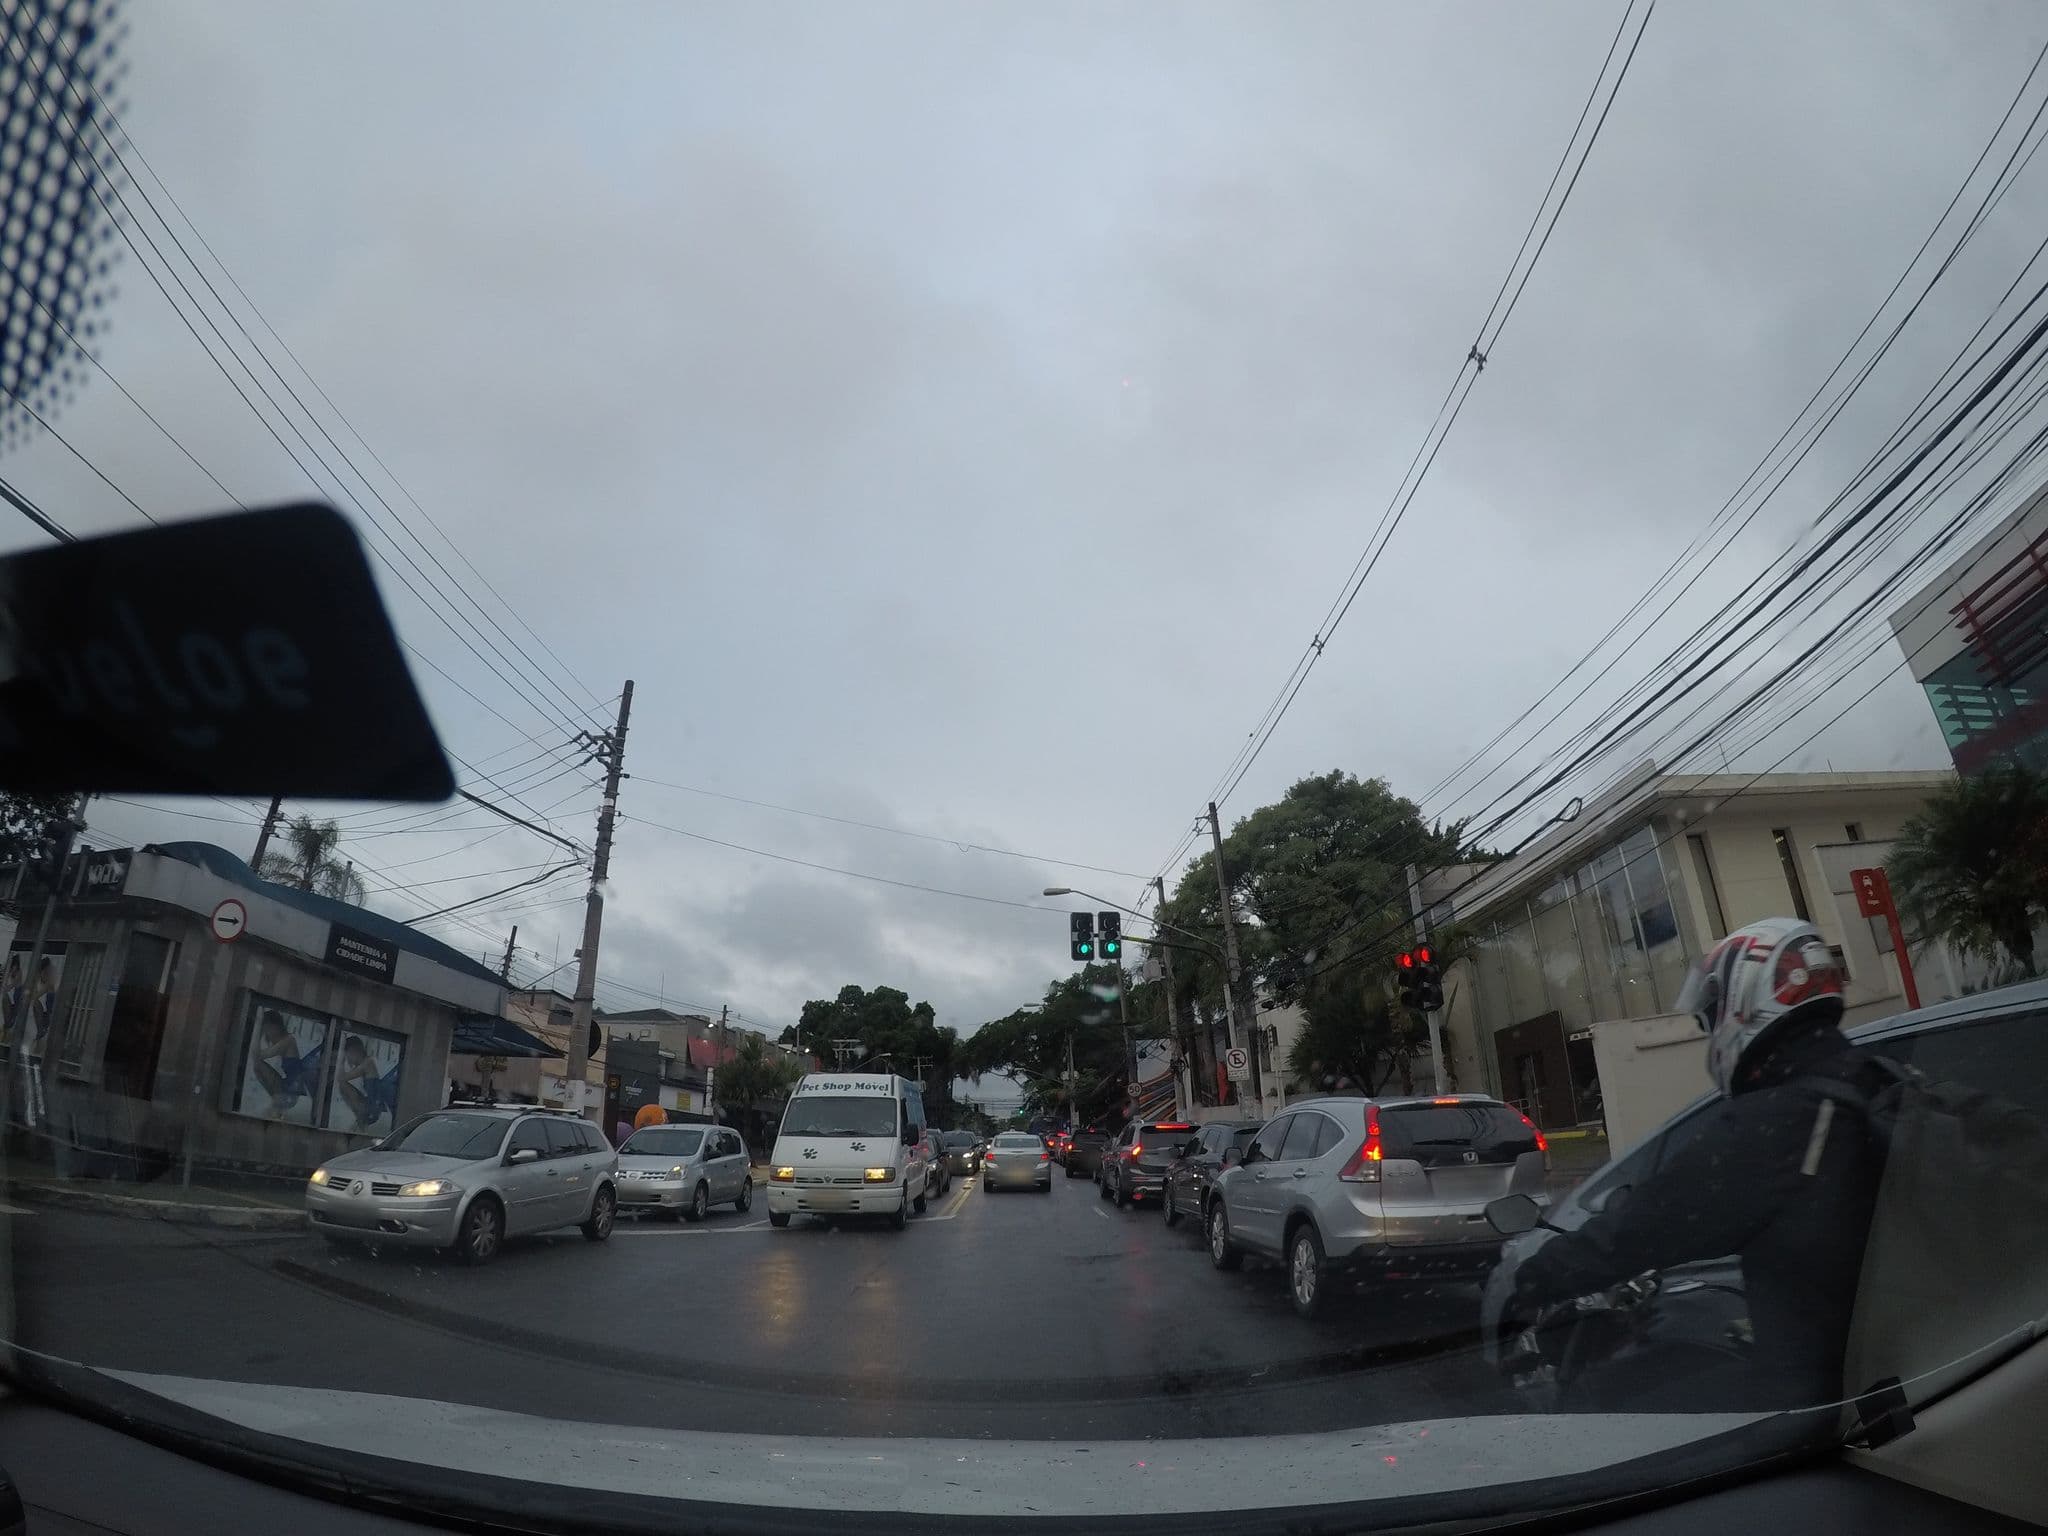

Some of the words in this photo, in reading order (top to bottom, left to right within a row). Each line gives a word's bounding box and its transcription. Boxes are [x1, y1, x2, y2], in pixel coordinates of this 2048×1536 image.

[340, 937, 380, 958] MANTENHA
[336, 948, 365, 964] CIDADE
[365, 958, 387, 972] LIMPA
[822, 1082, 851, 1091] Shop
[1129, 1085, 1140, 1094] 50
